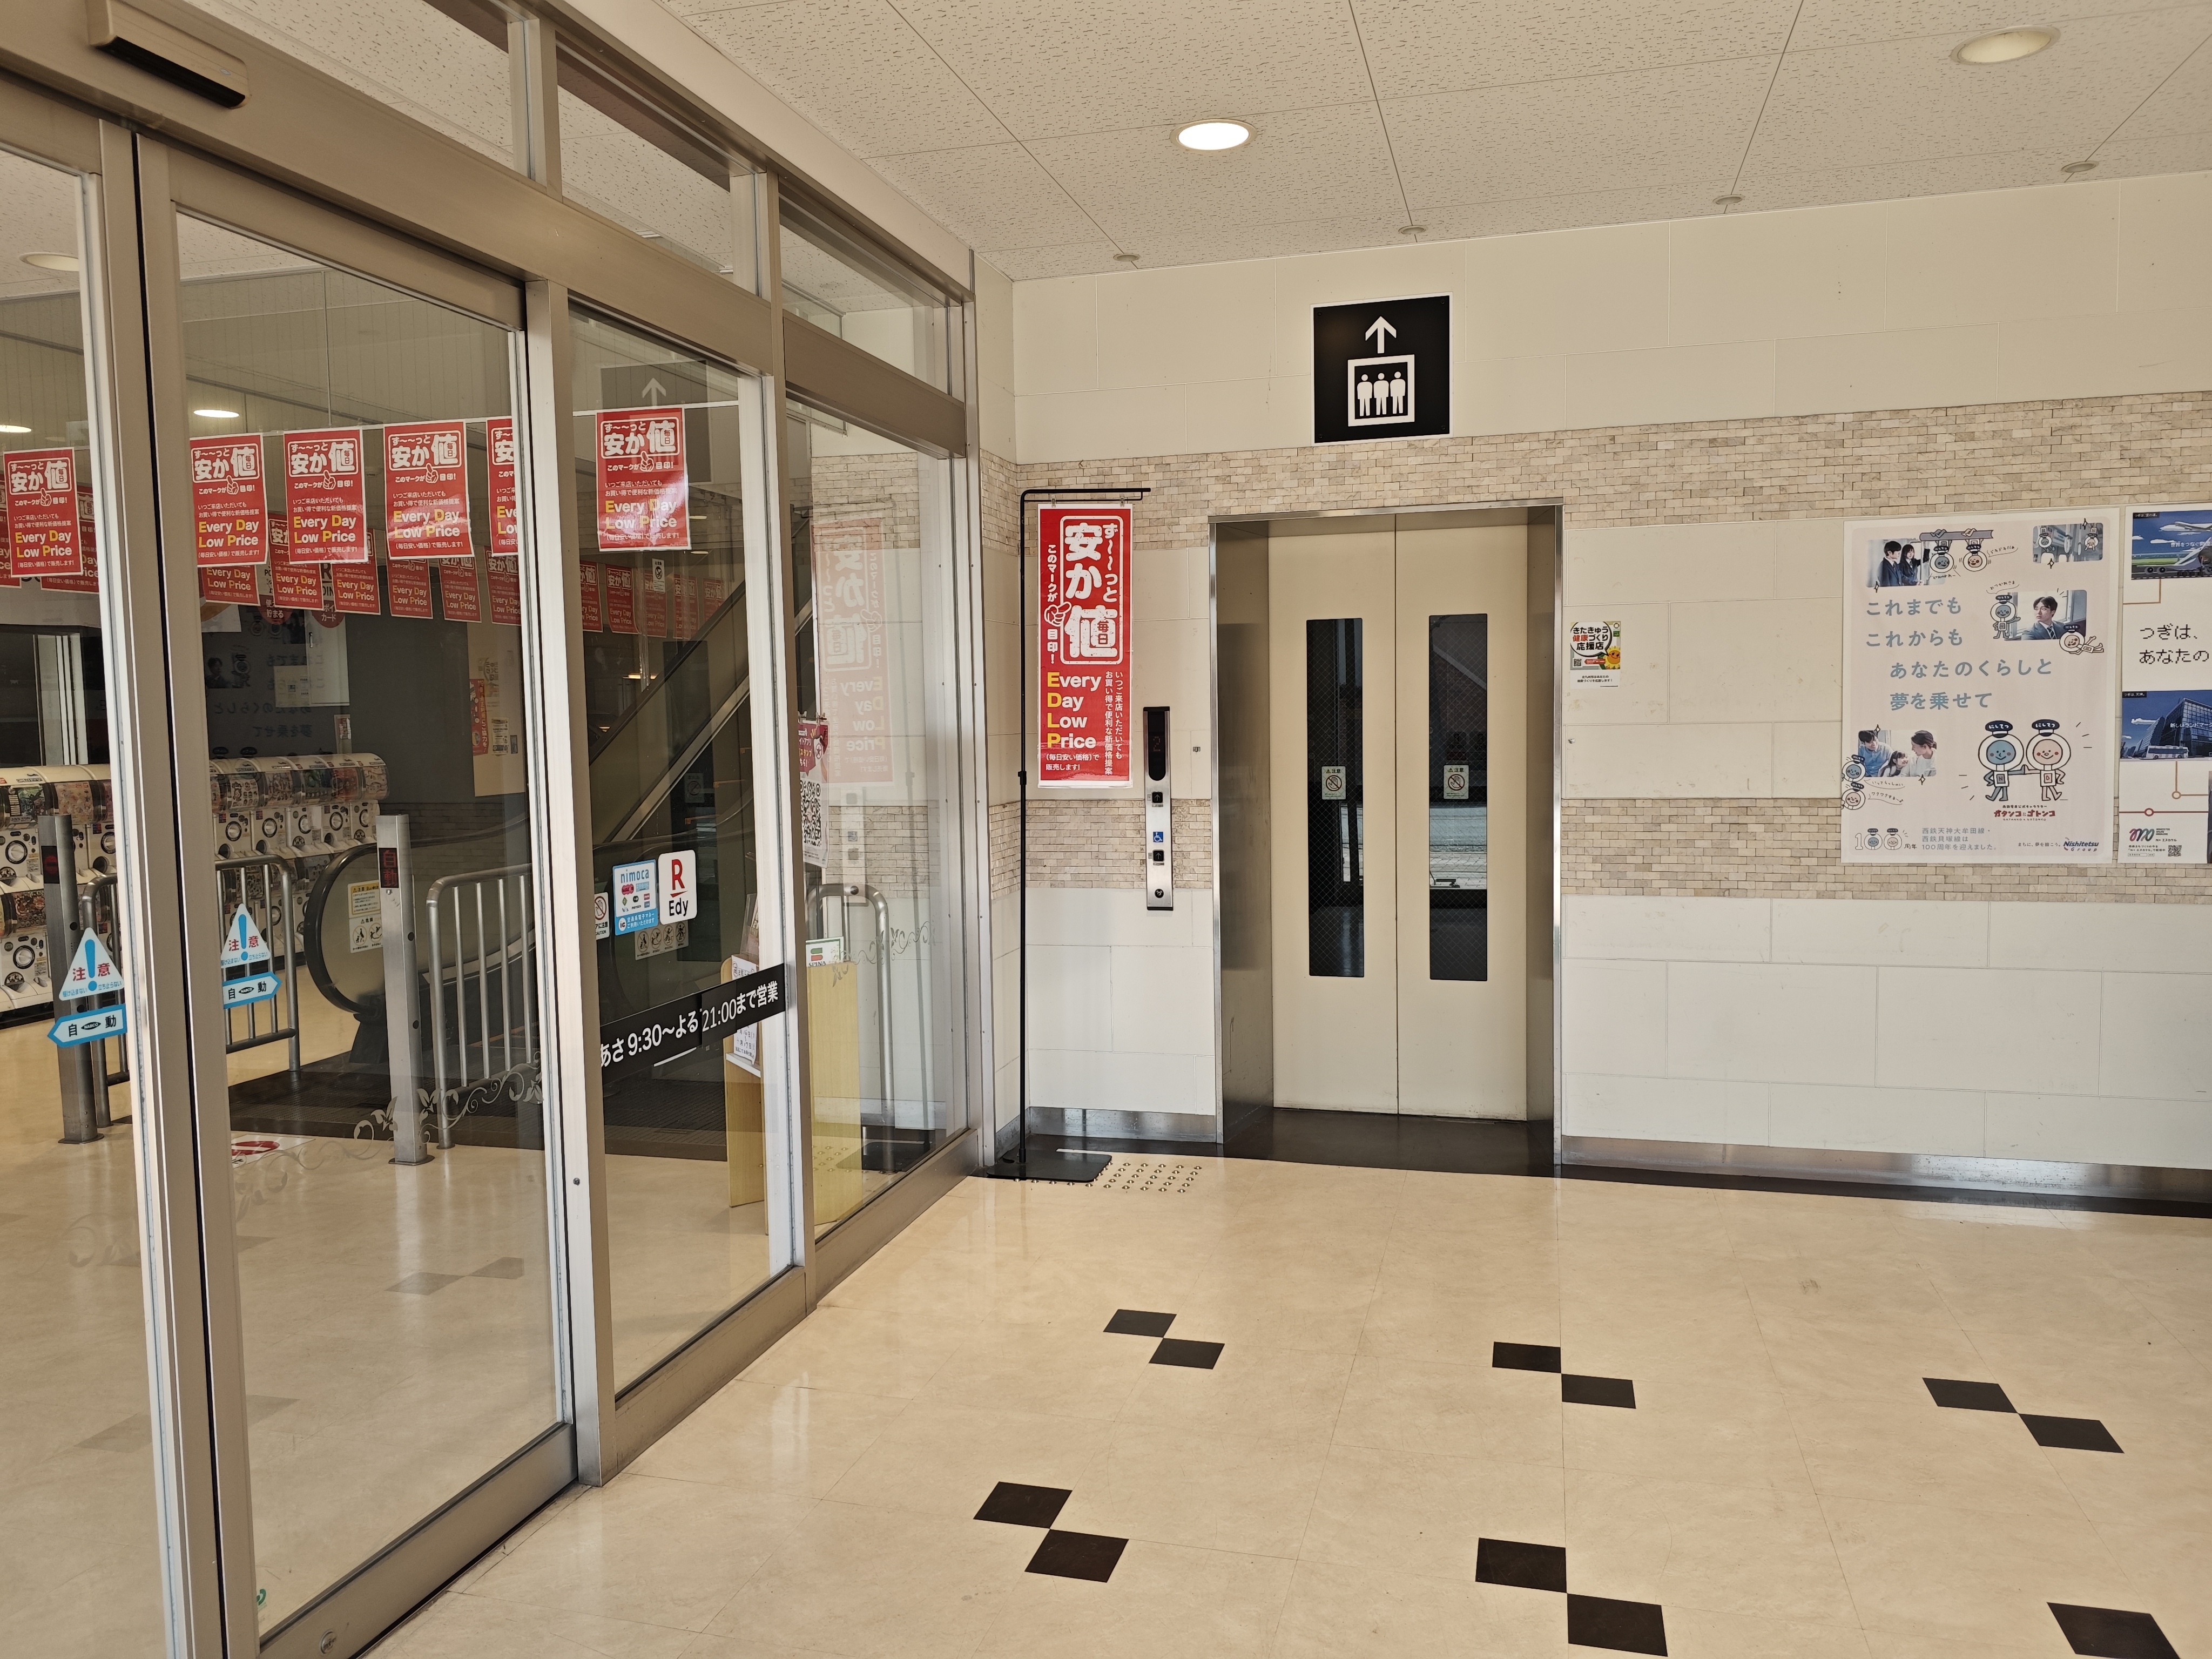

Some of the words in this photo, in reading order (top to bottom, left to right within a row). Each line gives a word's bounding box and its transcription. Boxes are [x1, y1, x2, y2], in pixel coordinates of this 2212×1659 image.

[607, 463, 639, 471] このマークが
[15, 498, 40, 506] このマークが
[605, 500, 645, 514] Every
[650, 498, 677, 513] Day
[293, 516, 327, 530] Every
[332, 515, 356, 529] Day
[393, 511, 430, 524] Every
[434, 509, 460, 523] Day
[606, 517, 635, 529] Low
[639, 516, 677, 528] Price
[199, 521, 232, 534] Every
[236, 520, 259, 532] Day
[394, 527, 422, 538] Low
[426, 525, 460, 537] Price
[15, 531, 46, 544] Every
[49, 530, 71, 542] Day
[199, 537, 224, 548] Low
[227, 535, 258, 546] Price
[294, 532, 319, 544] Low
[322, 530, 356, 542] Price
[17, 547, 39, 558] Low
[43, 545, 72, 556] Price
[1103, 523, 1118, 603] ず〜〜っと
[206, 568, 231, 579] Every
[234, 569, 251, 581] Day
[275, 573, 298, 585] Every
[301, 576, 316, 586] Day
[1047, 544, 1058, 602] このマークが
[207, 578, 226, 588] Low
[229, 579, 251, 590] Price
[277, 584, 293, 594] Low
[296, 585, 317, 596] Price
[336, 579, 358, 591] Every
[360, 581, 374, 591] Day
[393, 585, 412, 596] Every
[414, 587, 427, 597] Day
[1064, 522, 1118, 658] 安か値
[338, 590, 353, 599] Low
[355, 591, 374, 601] Price
[393, 595, 408, 604] Low
[410, 597, 427, 606] Price
[445, 590, 462, 601] Every
[463, 592, 476, 602] Day
[492, 595, 508, 605] Every
[446, 601, 458, 609] Low
[460, 602, 476, 610] Price
[493, 604, 504, 613] Low
[1866, 597, 1962, 616] これまでも
[321, 613, 336, 622] カード
[610, 609, 621, 617] Every
[621, 610, 632, 618] Day
[621, 617, 632, 625] Price
[1097, 621, 1109, 644] 毎日
[1866, 629, 1963, 647] これからも
[2140, 623, 2197, 640] つぎは、
[1047, 628, 1058, 664] 目印!
[1576, 642, 1604, 650] 応援店
[2139, 649, 2209, 665] あなたの
[1890, 658, 2053, 680] あなたのくらしと
[1047, 672, 1102, 692] Every
[1047, 692, 1084, 712] Day
[1890, 692, 1993, 711] 夢を乗せて
[1047, 712, 1088, 729] Low
[1115, 671, 1123, 759] いつご来店いただいても
[1104, 671, 1113, 775] お買い得で便利な新価格提案
[1047, 733, 1096, 748] Price
[383, 850, 397, 887] 自動
[671, 859, 685, 890] R
[621, 869, 650, 884] nimoca
[669, 898, 689, 916] Edy
[229, 939, 239, 952] 注
[248, 935, 259, 948] 意
[73, 967, 86, 981] 注
[97, 962, 111, 977] 意
[228, 988, 235, 1000] 自
[258, 981, 267, 993] 動
[68, 1024, 77, 1037] 自
[105, 1015, 116, 1028] 動
[601, 1037, 626, 1067] あさ
[702, 980, 778, 1033] 21:00まで営業
